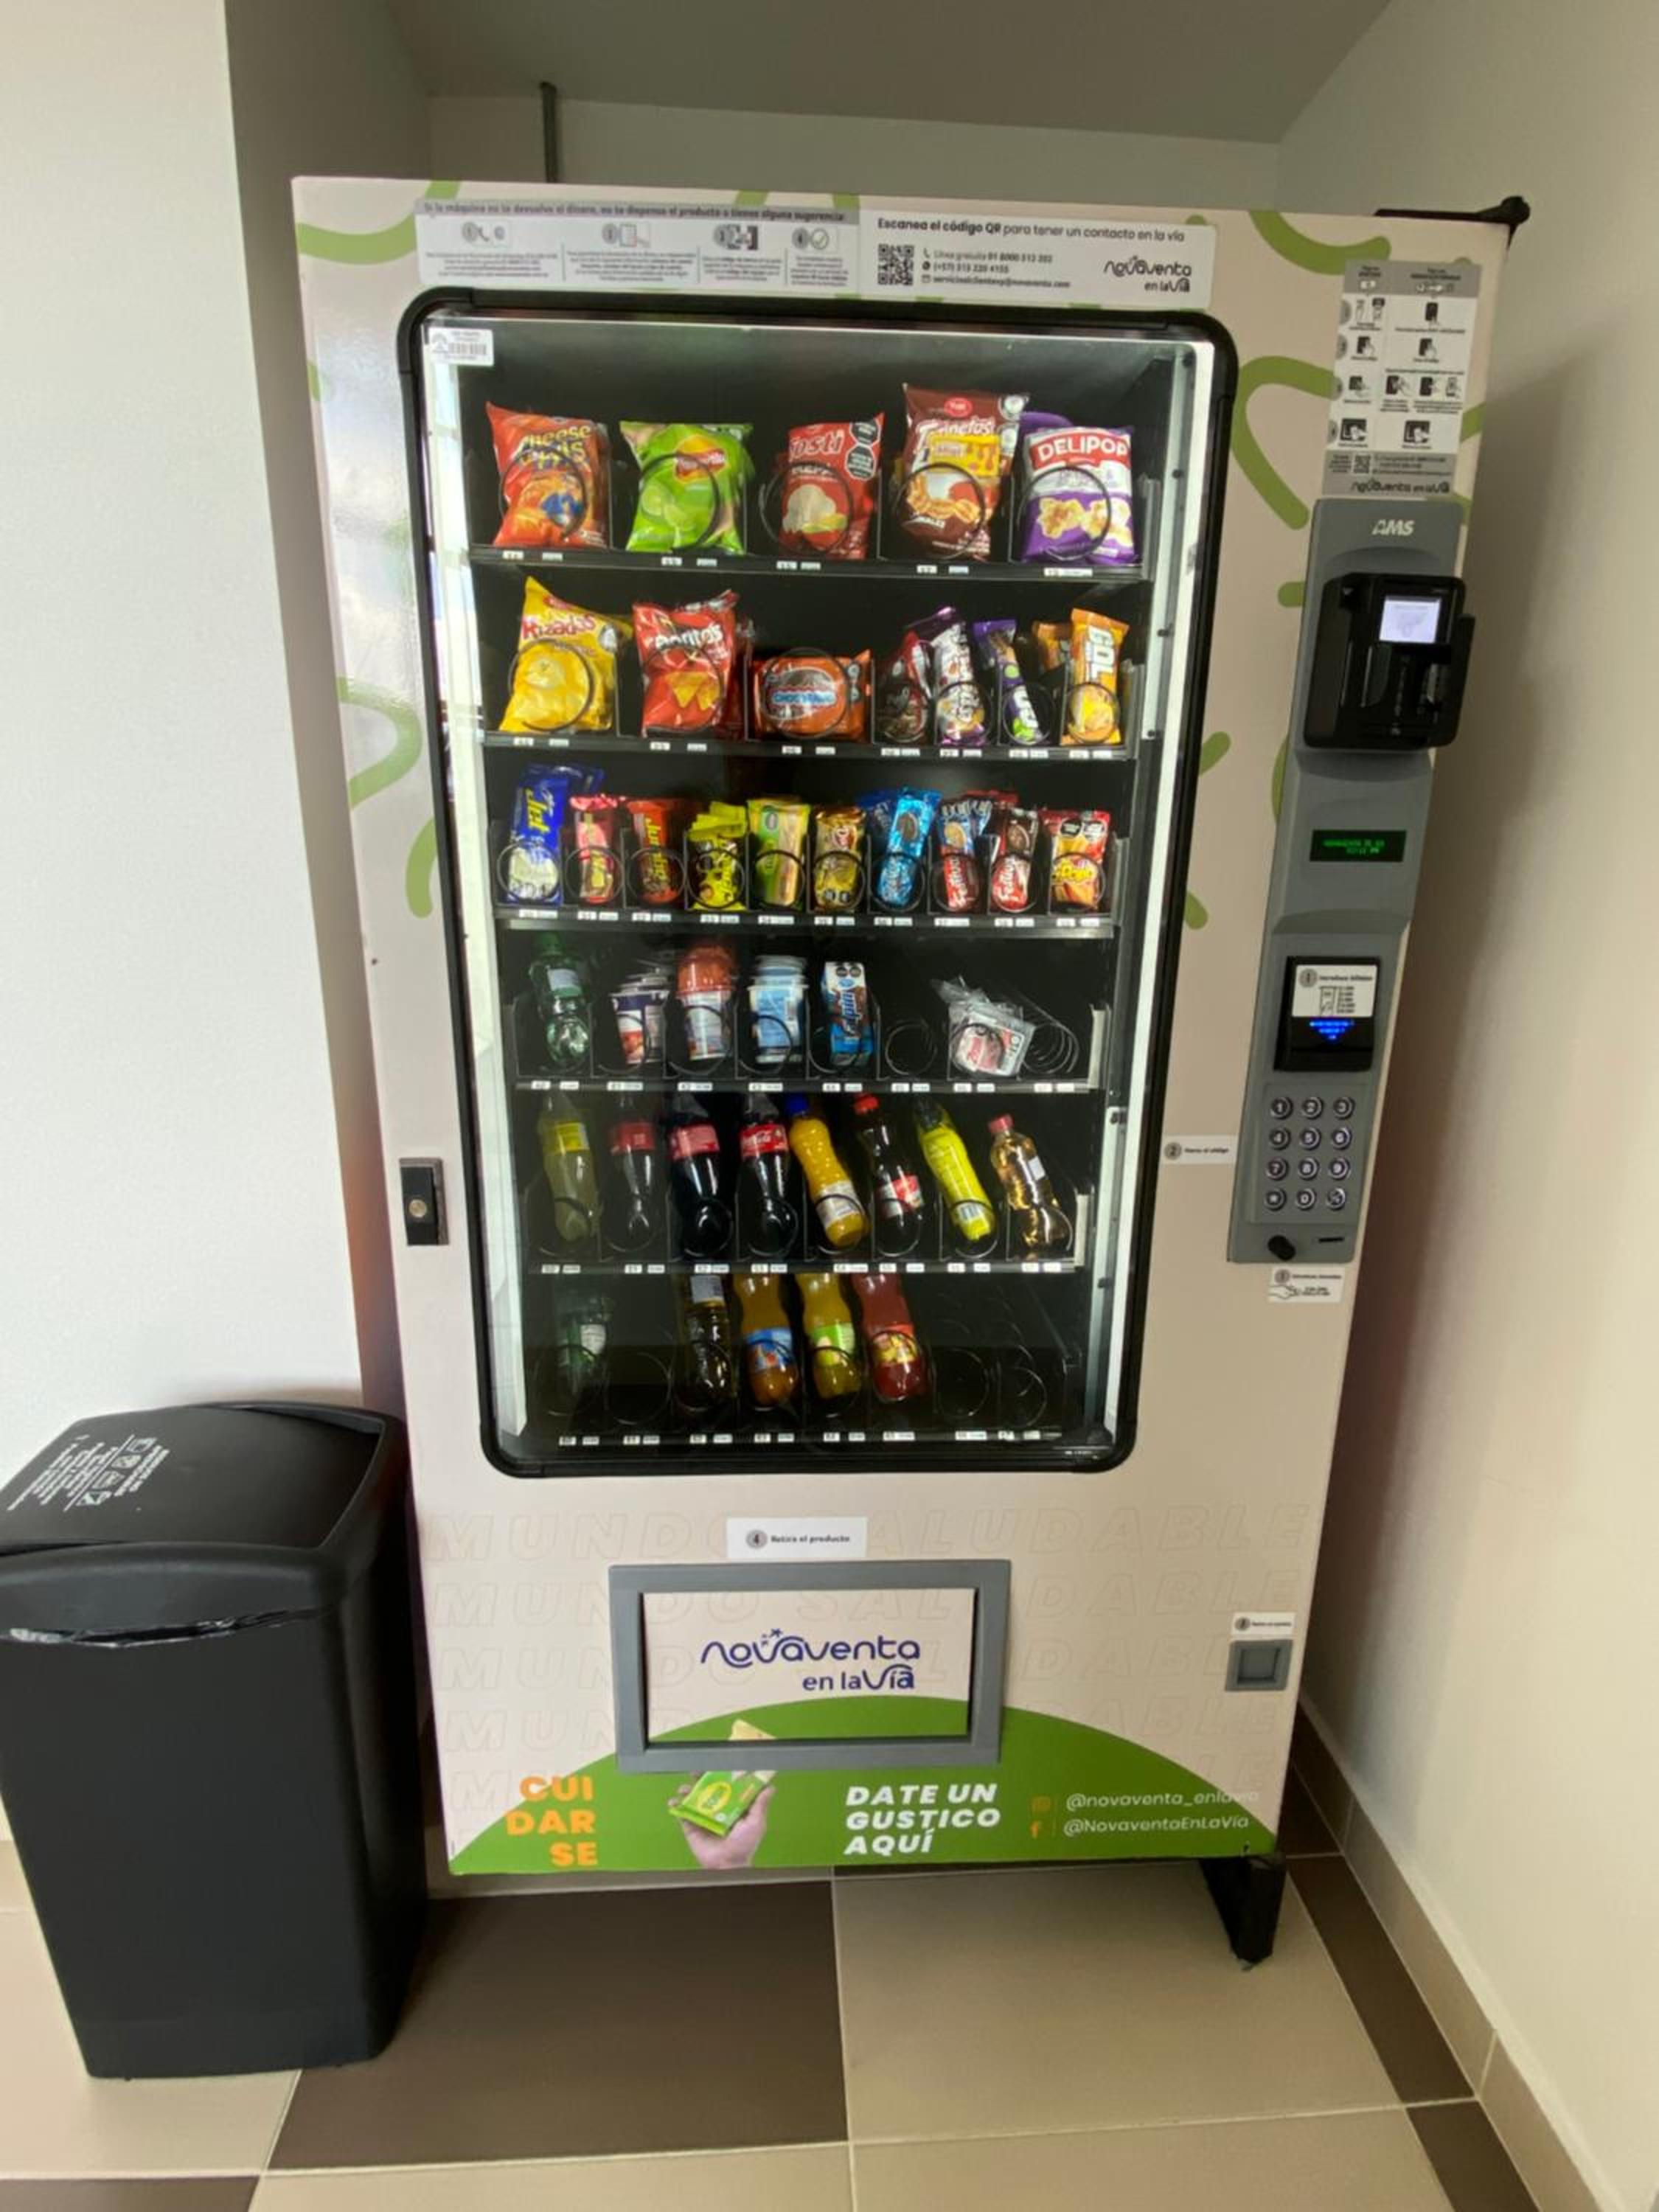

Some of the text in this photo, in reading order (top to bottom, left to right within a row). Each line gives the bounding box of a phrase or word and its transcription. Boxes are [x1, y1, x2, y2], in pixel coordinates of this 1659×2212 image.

[877, 218, 928, 231] Escanea
[930, 220, 941, 231] el
[942, 220, 983, 235] código
[1003, 224, 1032, 237] para
[1033, 225, 1064, 237] tener
[1066, 227, 1081, 237] un
[1083, 226, 1135, 240] contacto
[1138, 231, 1152, 241] en
[1154, 229, 1165, 241] la
[1144, 282, 1158, 291] en
[1037, 435, 1129, 462] DELIPOP
[1371, 519, 1415, 536] AMS
[700, 1631, 922, 1669] novaventa
[802, 1674, 834, 1691] en
[519, 1775, 594, 1803] CUI
[846, 1782, 998, 1806] DATE UN
[505, 1809, 597, 1836] DAR
[846, 1807, 1002, 1831] GUSTICO
[549, 1841, 599, 1868] SE
[843, 1827, 936, 1857] AQUÍ
